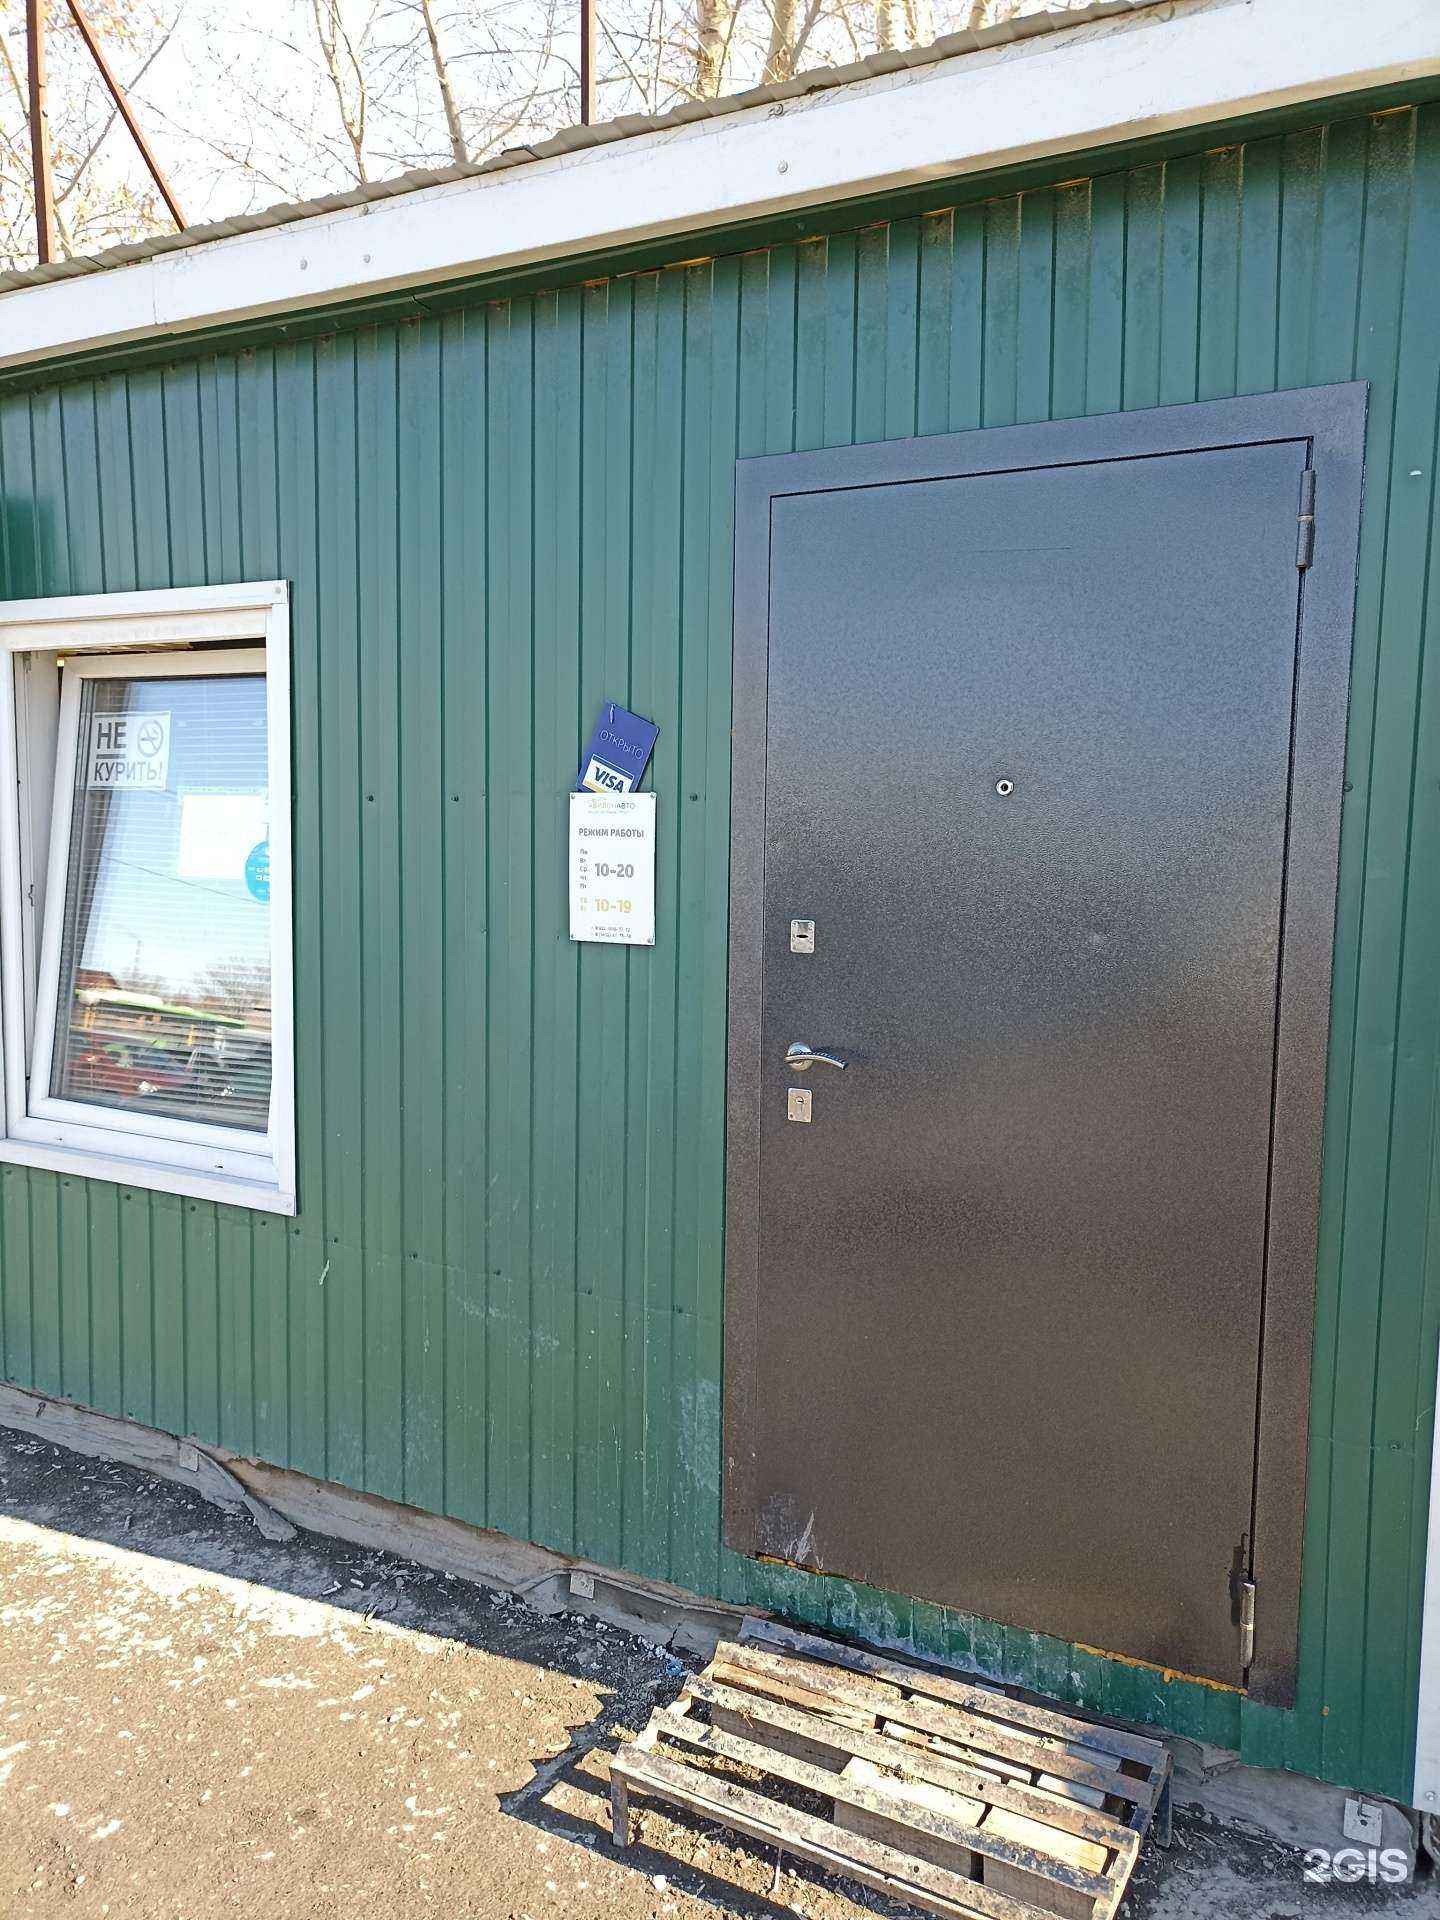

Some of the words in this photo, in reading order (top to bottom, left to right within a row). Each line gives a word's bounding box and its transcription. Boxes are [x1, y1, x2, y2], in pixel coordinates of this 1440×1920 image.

[97, 722, 127, 749] НЕ
[600, 729, 644, 760] ОТКРЫТО
[94, 761, 163, 781] КУРИТЬ!
[594, 766, 625, 793] VISA
[578, 828, 608, 837] РЕЖИМ
[610, 828, 645, 838] РАБОТЫ
[594, 863, 634, 878] 10-20
[594, 898, 632, 913] 10-19
